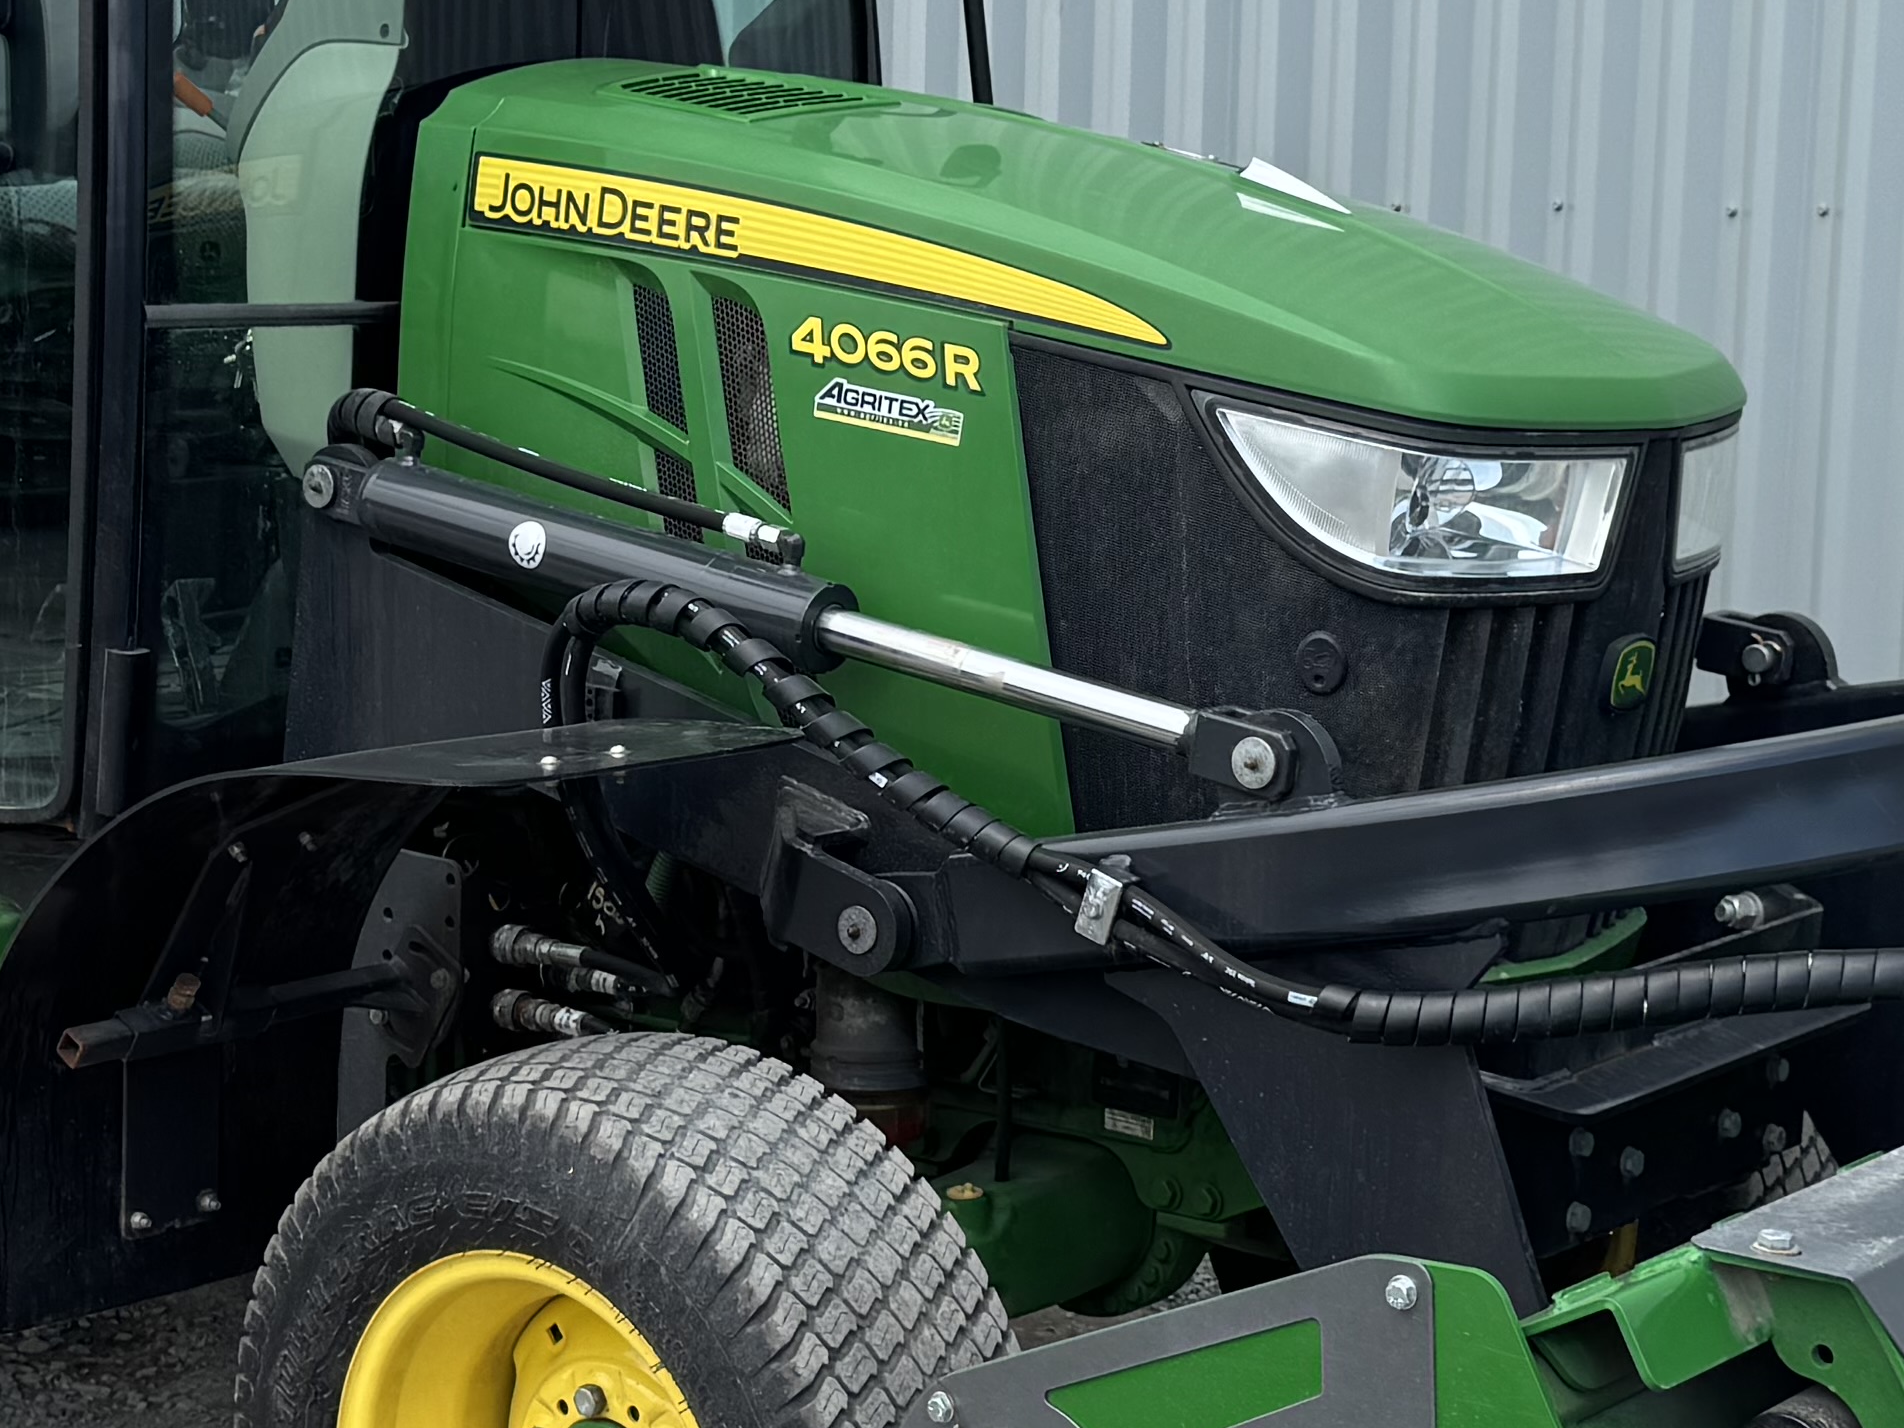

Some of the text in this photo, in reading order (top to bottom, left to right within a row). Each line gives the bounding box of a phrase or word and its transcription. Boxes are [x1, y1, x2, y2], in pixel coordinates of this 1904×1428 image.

[489, 172, 741, 252] JOHN DEERE
[819, 382, 929, 422] AGRITEX
